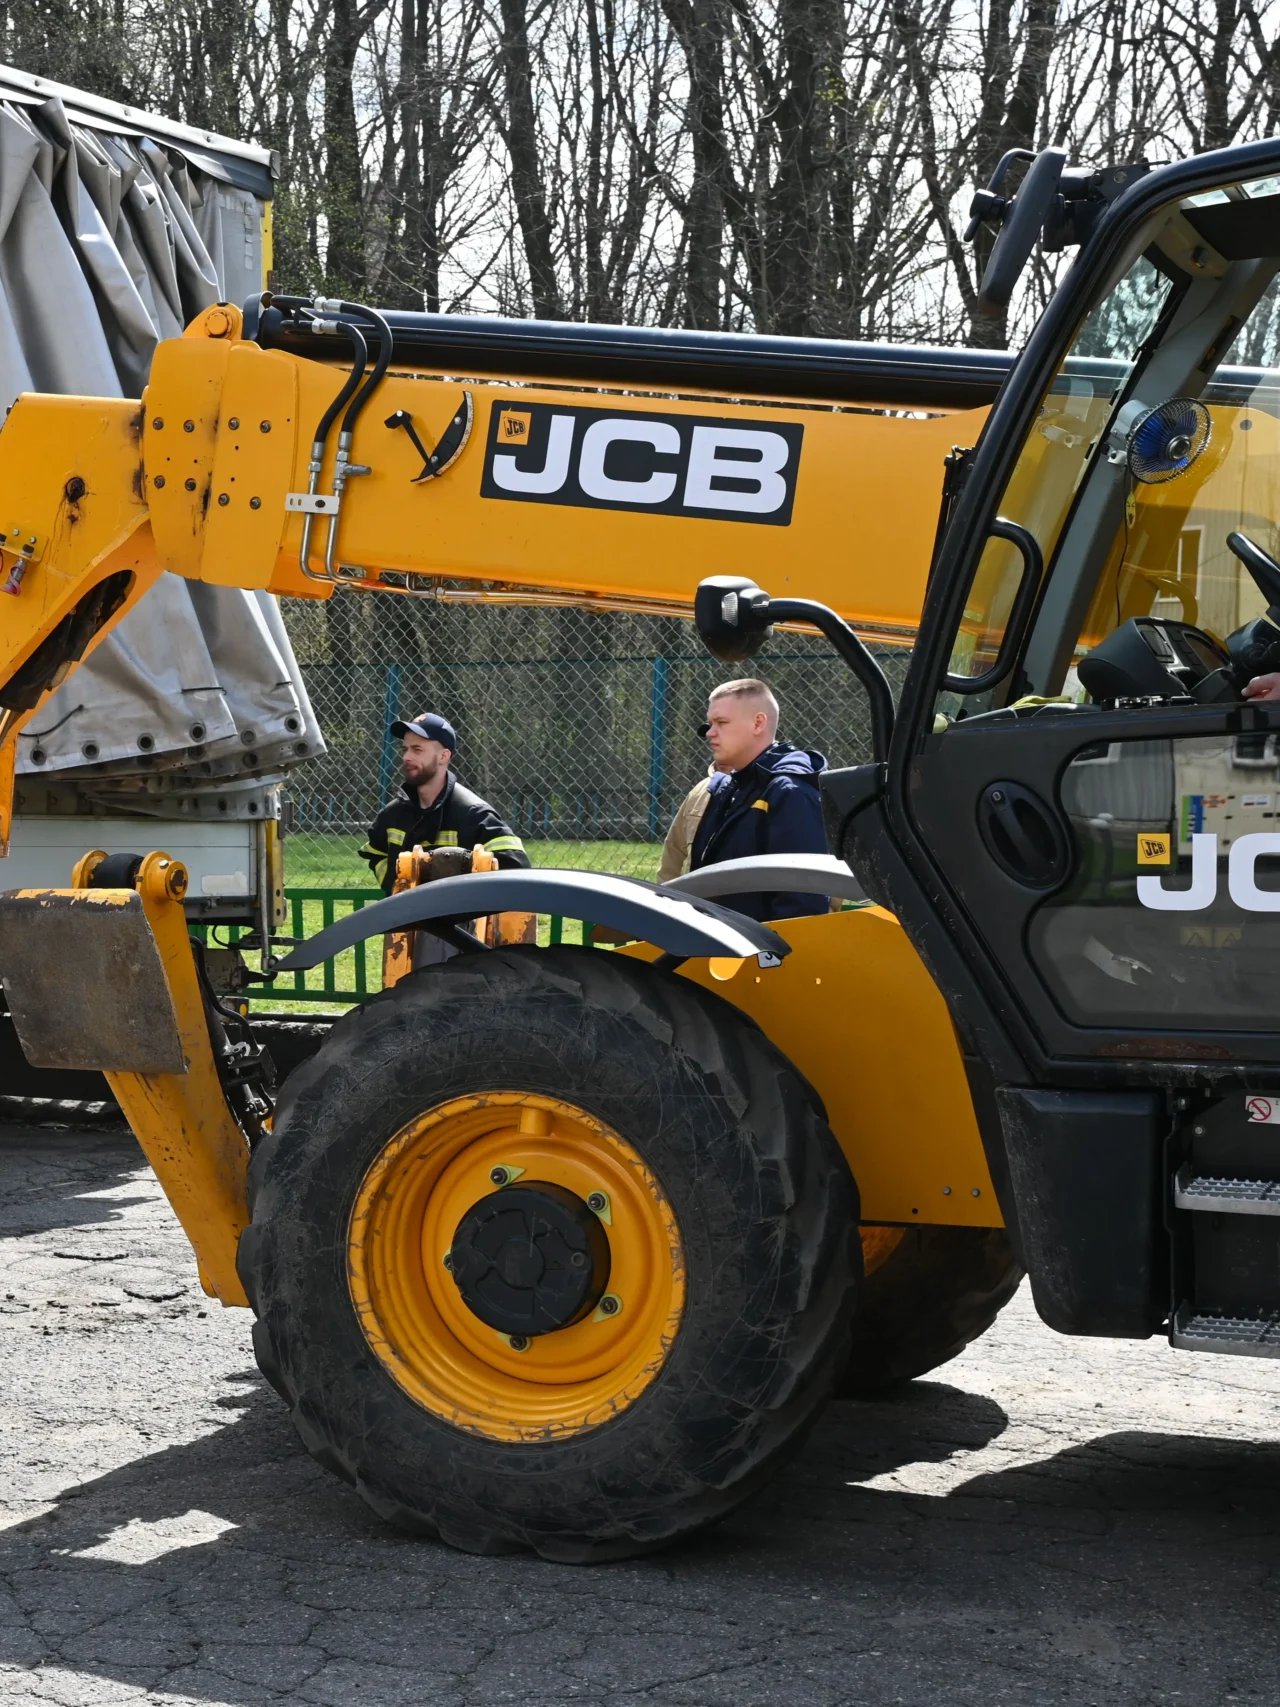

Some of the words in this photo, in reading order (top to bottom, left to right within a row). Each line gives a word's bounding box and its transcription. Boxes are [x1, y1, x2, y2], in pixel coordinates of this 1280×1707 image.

[506, 420, 525, 437] JCB
[492, 414, 790, 515] JCB
[1145, 841, 1165, 857] JCB
